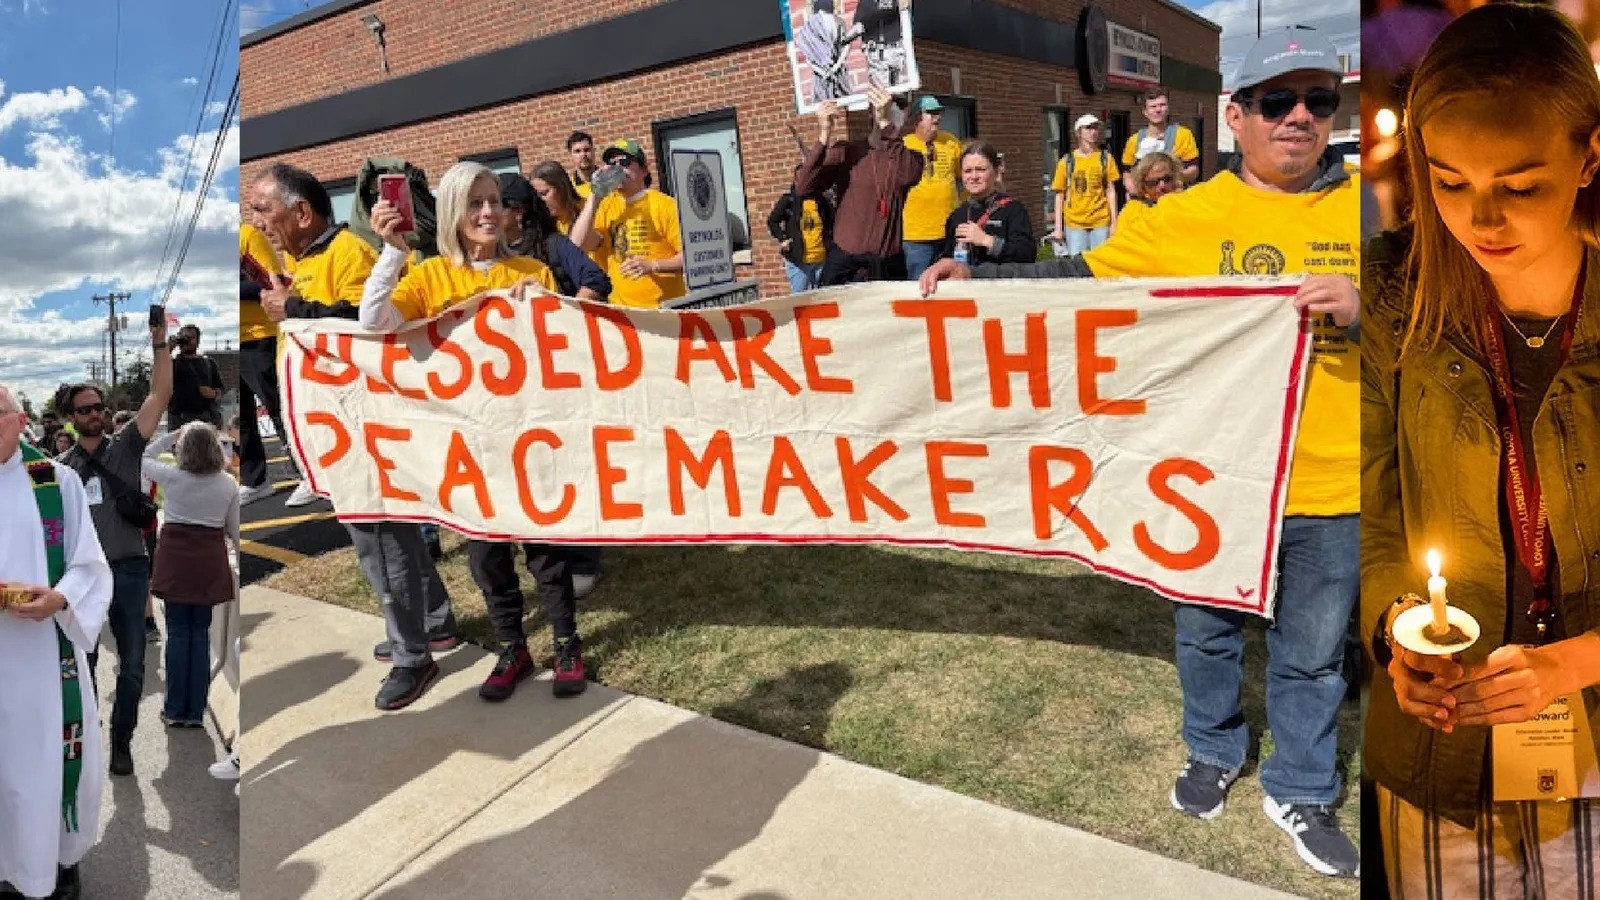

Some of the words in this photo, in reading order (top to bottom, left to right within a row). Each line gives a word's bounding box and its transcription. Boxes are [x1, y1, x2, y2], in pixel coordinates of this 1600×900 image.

[675, 301, 854, 397] ARE
[890, 299, 1147, 416] THE
[1502, 426, 1517, 467] LOYOLA
[304, 411, 1222, 572] PEACEMAKERS
[1508, 466, 1529, 523] UNIVERSITY
[1533, 530, 1545, 567] LOYOLA
[1533, 710, 1569, 721] oward
